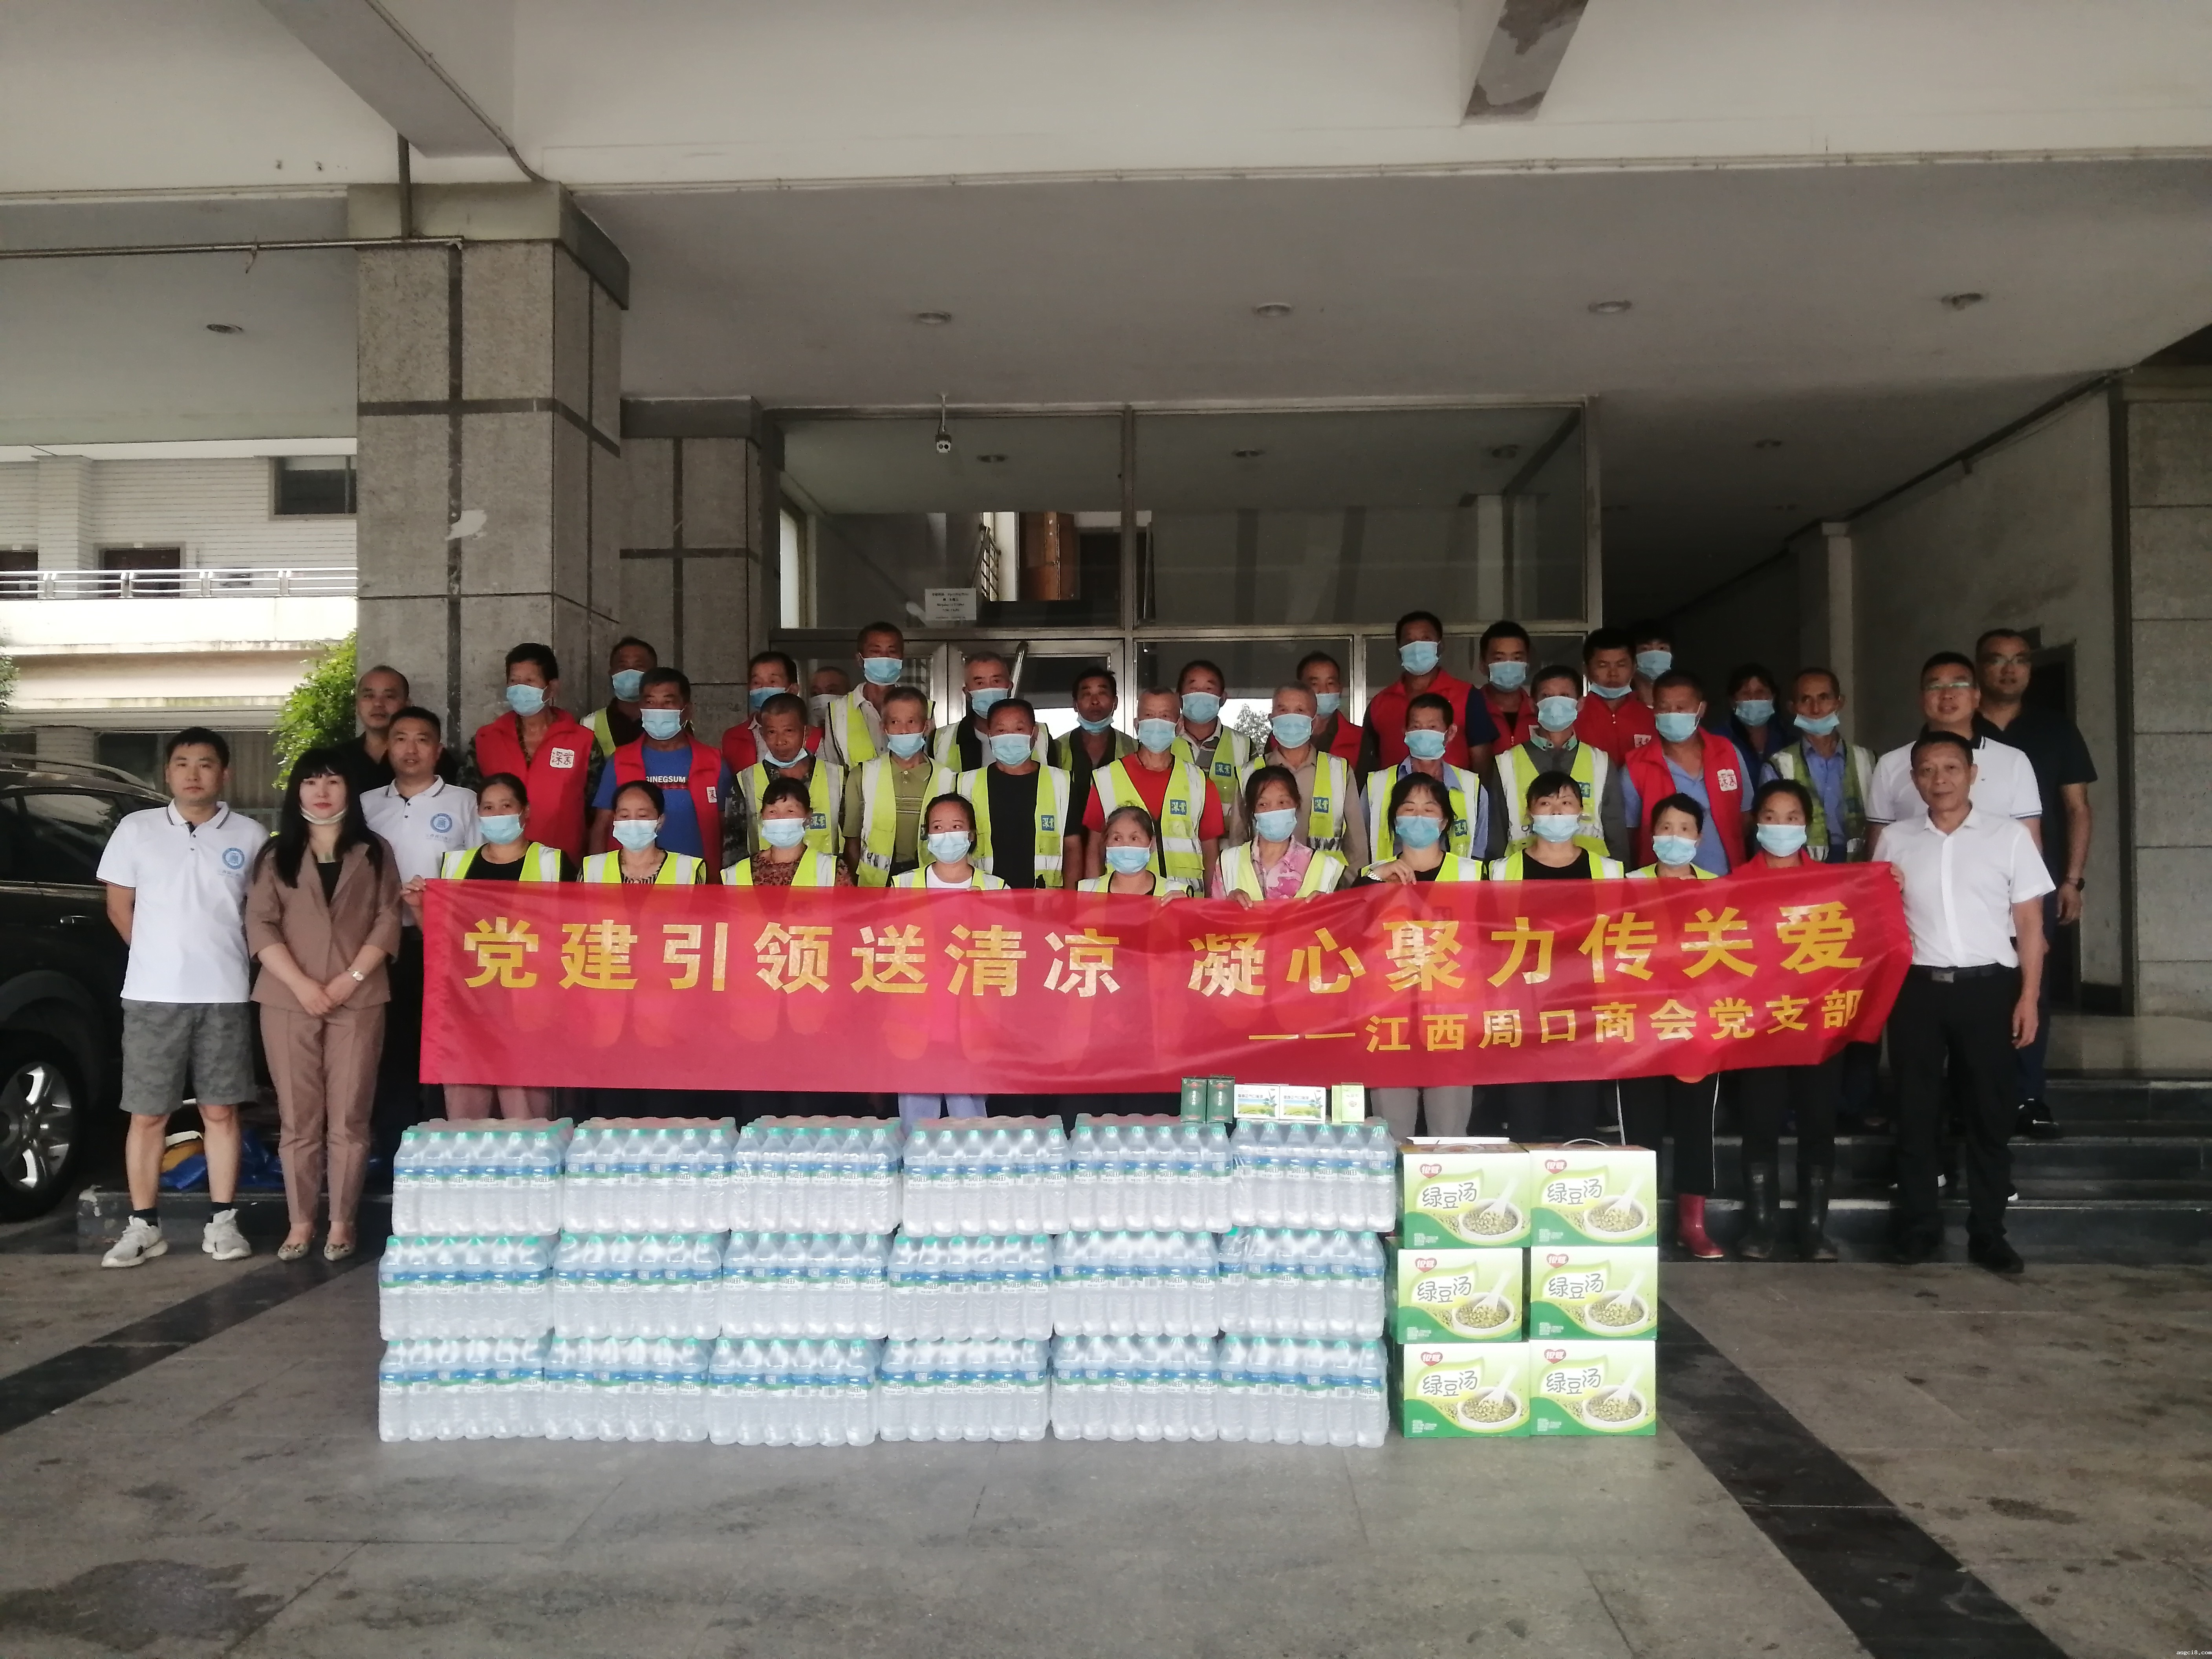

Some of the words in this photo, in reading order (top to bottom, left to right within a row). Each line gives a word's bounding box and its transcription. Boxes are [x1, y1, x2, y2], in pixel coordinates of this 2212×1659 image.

[463, 917, 1121, 998] 党建引领送清凉
[1188, 901, 1863, 997] 凝心聚力传关爱
[1422, 1182, 1477, 1209] 绿豆汤
[1547, 1179, 1602, 1205] 绿豆汤
[1417, 1276, 1472, 1303] 绿豆汤
[1549, 1273, 1604, 1299] 绿豆汤
[1422, 1370, 1477, 1396] 绿豆汤
[1546, 1368, 1600, 1394] 绿豆汤
